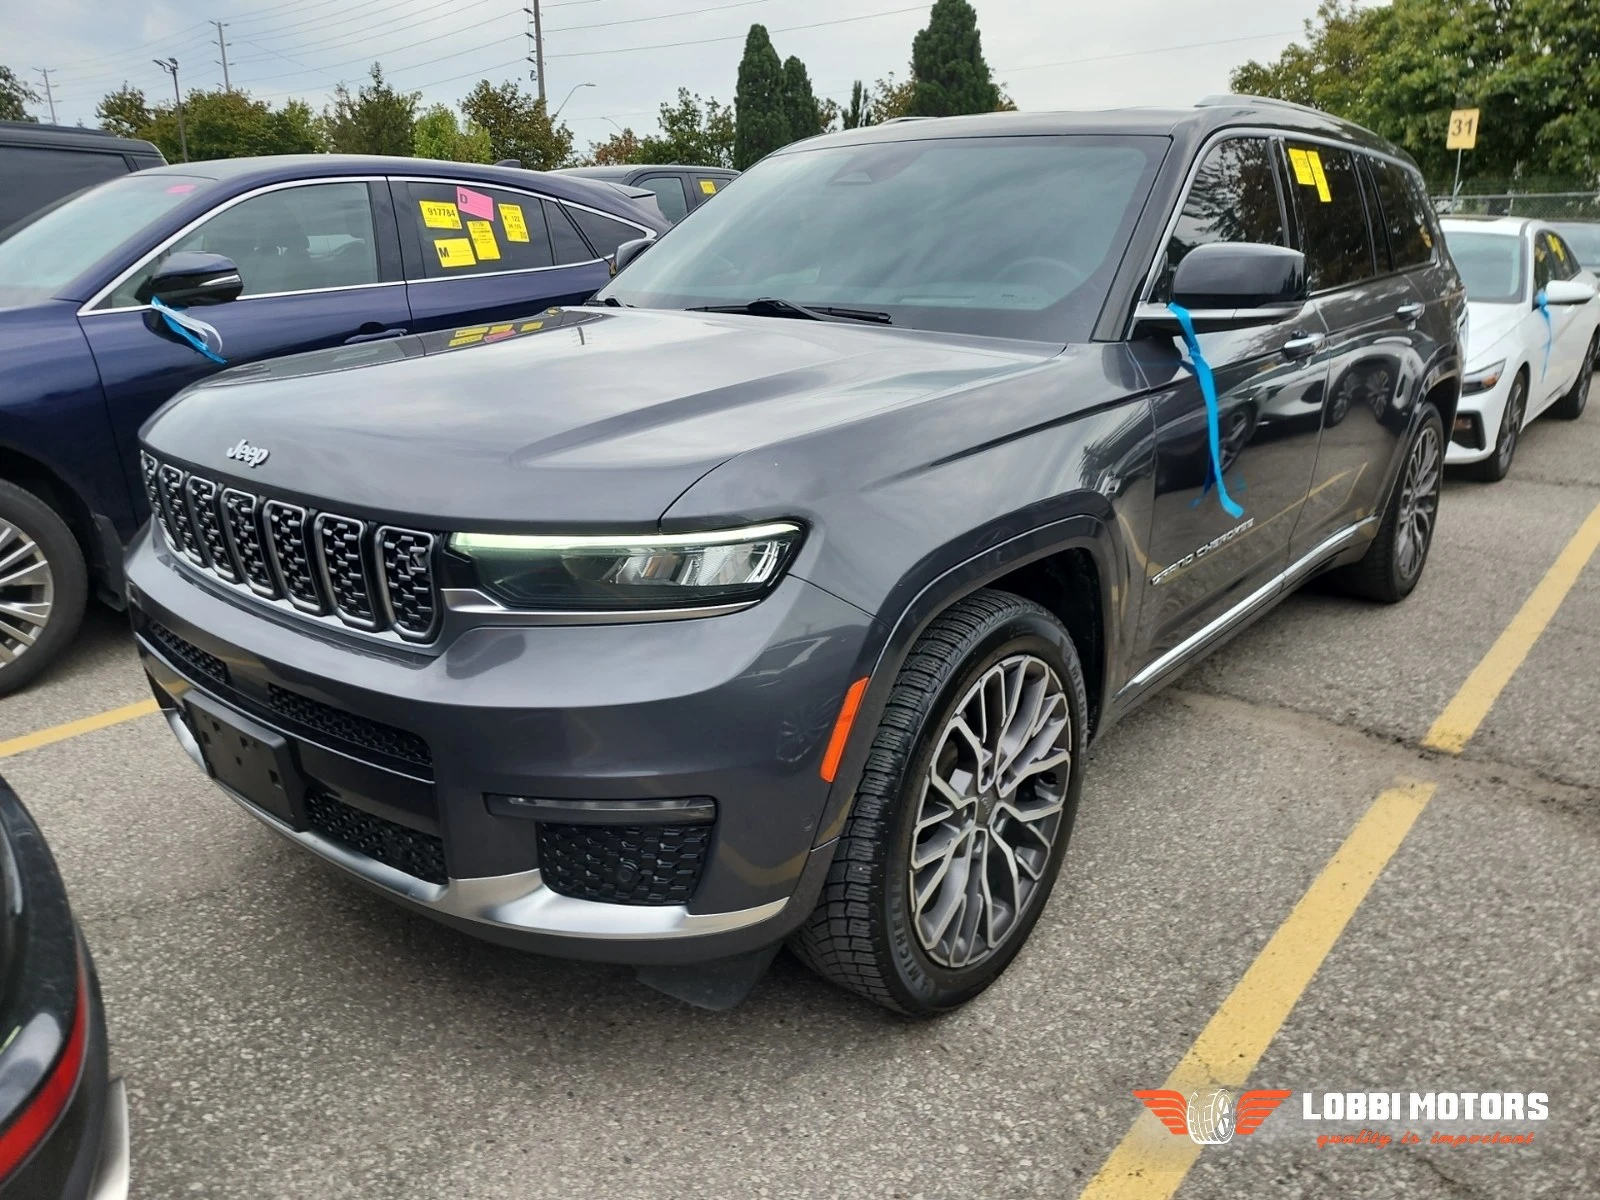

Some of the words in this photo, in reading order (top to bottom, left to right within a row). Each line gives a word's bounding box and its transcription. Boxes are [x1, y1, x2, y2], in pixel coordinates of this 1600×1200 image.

[1451, 118, 1474, 137] 31
[427, 207, 456, 217] 917784
[438, 247, 450, 258] M
[226, 438, 270, 468] Jeep
[1151, 552, 1195, 586] GRAND
[1195, 517, 1255, 557] CHEROKEE
